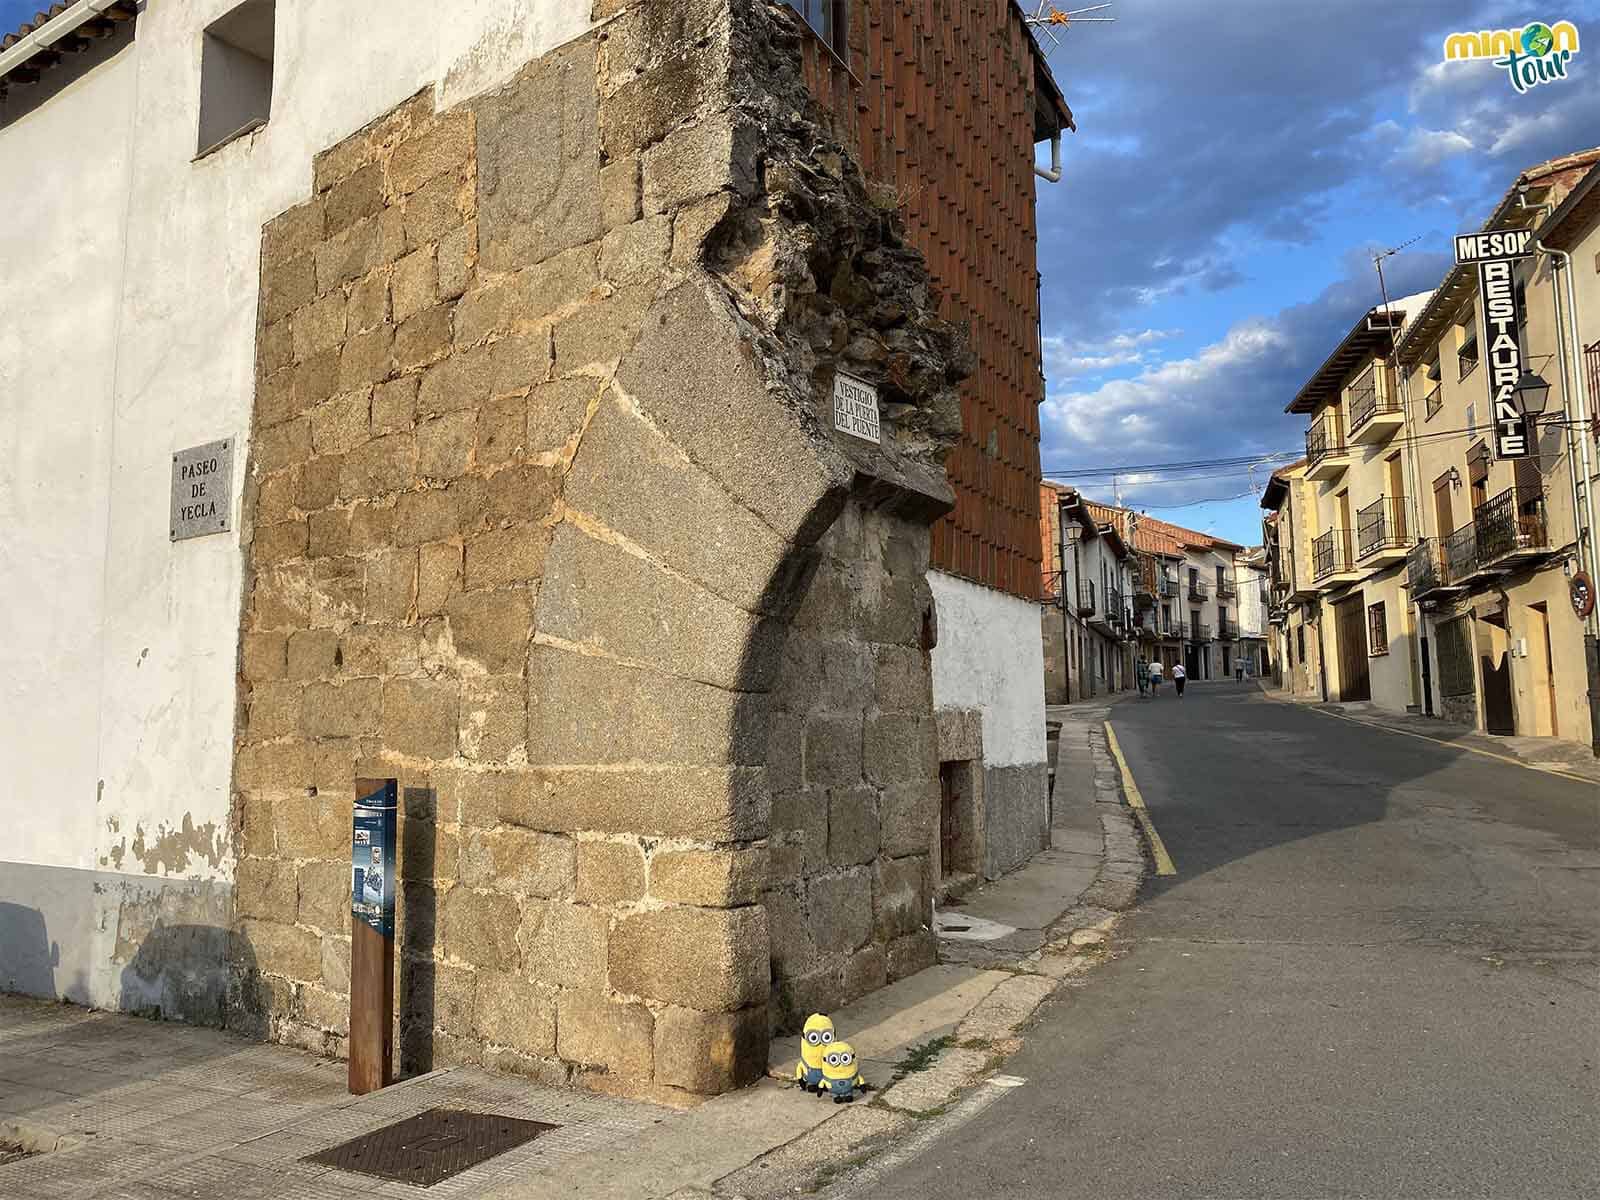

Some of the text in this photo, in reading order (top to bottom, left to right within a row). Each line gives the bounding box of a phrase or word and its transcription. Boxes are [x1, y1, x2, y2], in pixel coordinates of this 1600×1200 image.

[1458, 231, 1531, 260] MESON
[1484, 262, 1526, 455] RESTAURANTE
[840, 381, 872, 406] VESTIGIO
[835, 394, 878, 425] DE LA PUERTA
[835, 410, 879, 439] DEL PUENTE
[181, 458, 217, 480] PASEO
[191, 482, 206, 498] DE
[181, 501, 216, 520] YECLA
